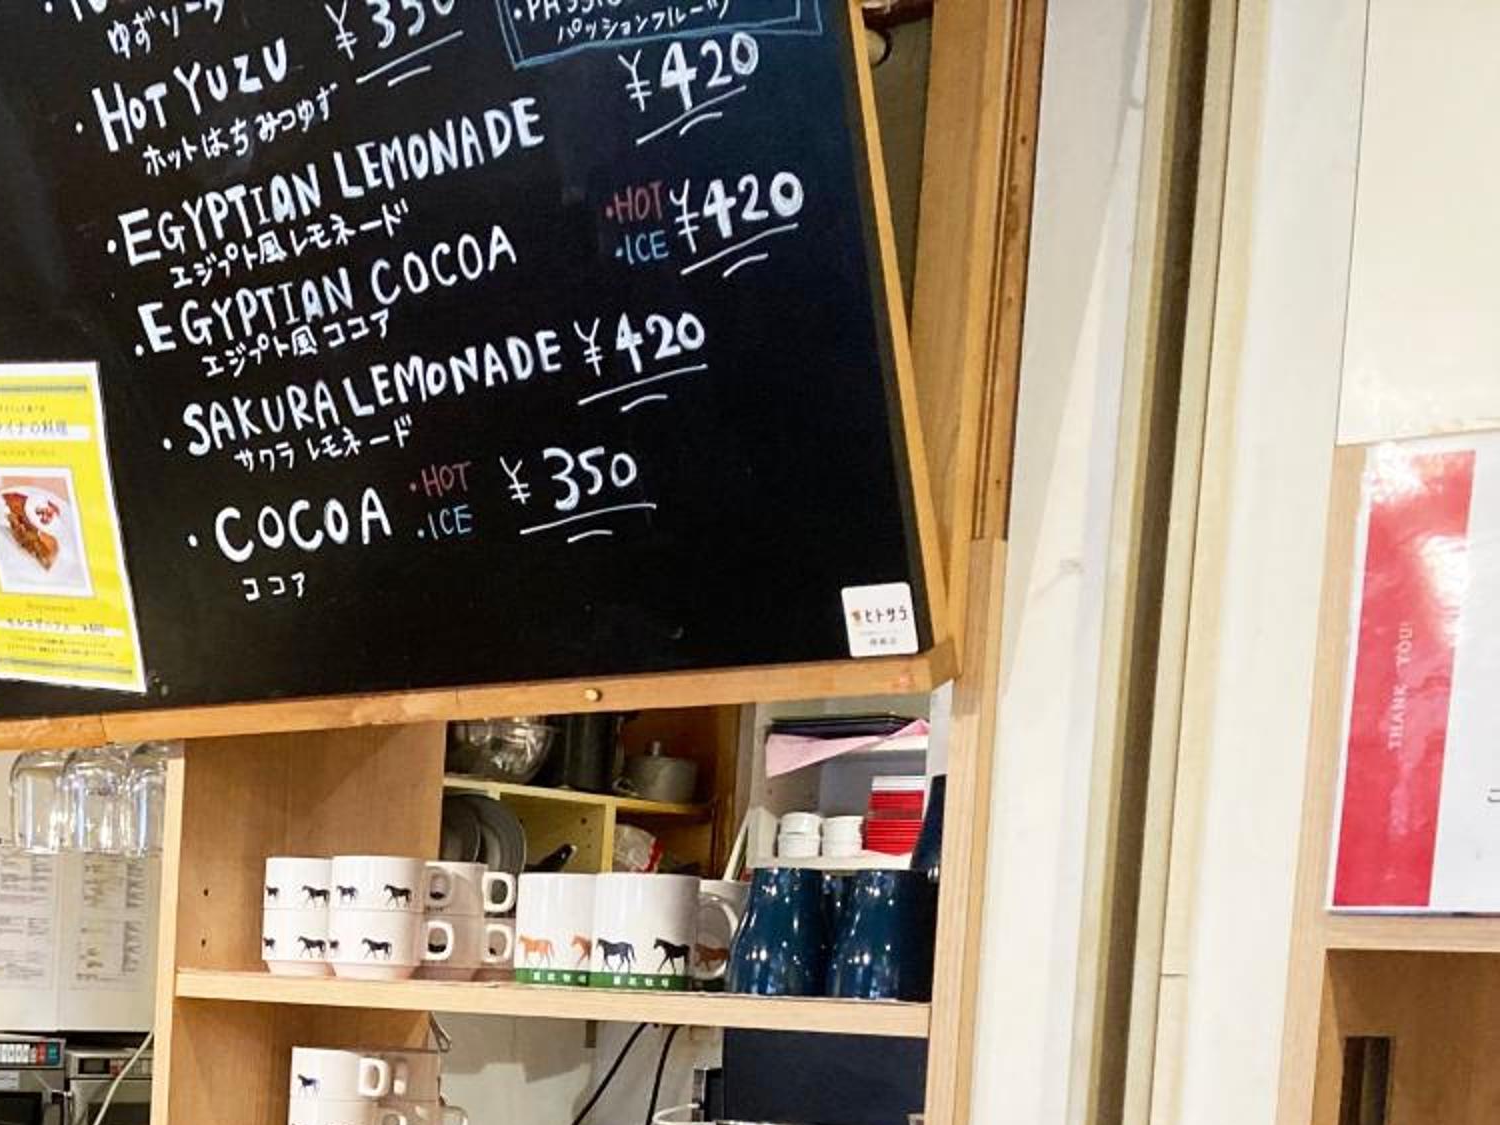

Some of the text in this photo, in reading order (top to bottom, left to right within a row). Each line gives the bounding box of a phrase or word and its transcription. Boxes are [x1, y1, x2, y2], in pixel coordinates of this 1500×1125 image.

[92, 38, 288, 153] HOT YUZU
[618, 31, 760, 112] ¥420
[142, 83, 339, 177] ホットはちみつゆず
[117, 97, 546, 268] EGYPTIAN LEMONADE
[612, 180, 665, 222] HOT
[669, 171, 804, 254] ¥420
[624, 230, 669, 265] ICE
[137, 224, 518, 355] EGYPTIAN COCOA
[182, 311, 706, 456] SAKURA LEMONADE ¥420
[214, 487, 393, 563] COCOA
[420, 461, 473, 498] HOT
[427, 503, 475, 540] ICE
[241, 571, 308, 602] ココア
[865, 604, 908, 624] ヒトサラ
[1388, 683, 1409, 751] THANK
